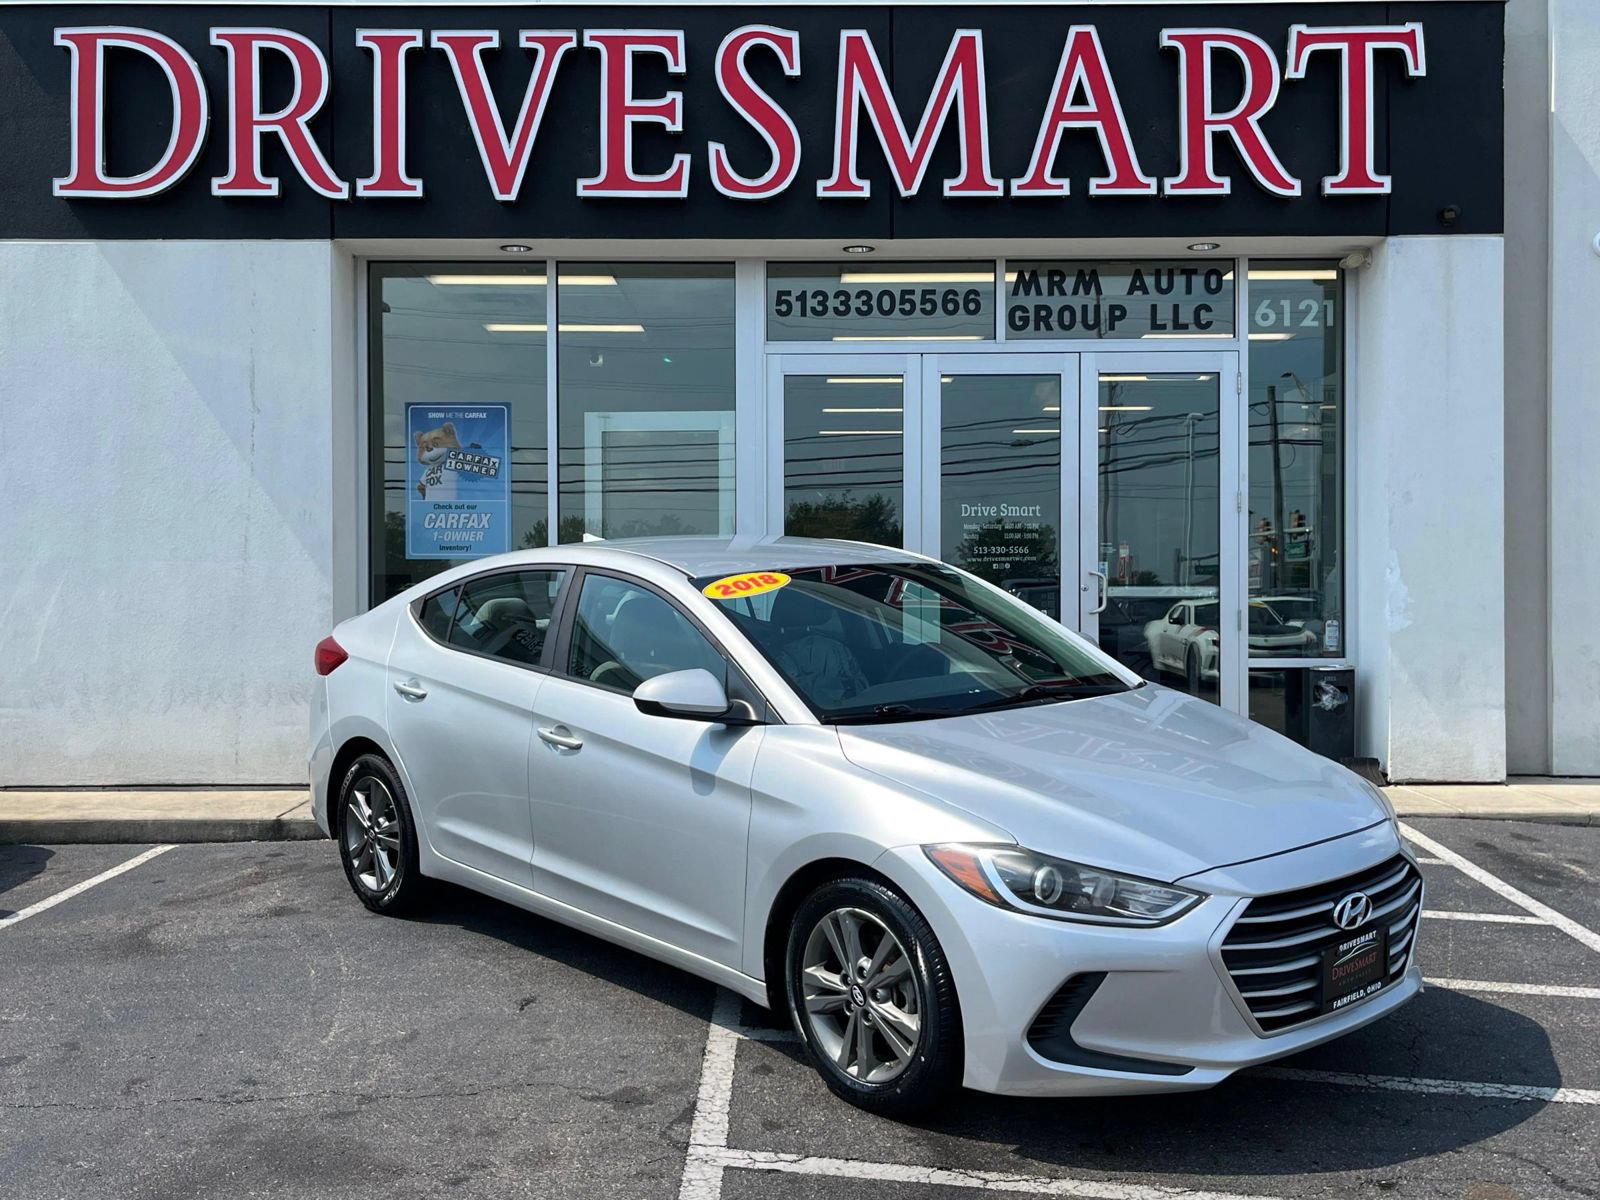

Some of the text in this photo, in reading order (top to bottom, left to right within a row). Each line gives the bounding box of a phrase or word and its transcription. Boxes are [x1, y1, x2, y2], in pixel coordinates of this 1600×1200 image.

[53, 23, 1427, 201] DRIVESMART
[1012, 268, 1223, 297] MRM AUTO
[775, 289, 982, 318] 5133305566
[1254, 299, 1335, 328] 6121
[1008, 303, 1214, 332] GROUP LLC
[449, 451, 499, 467] CARFAX
[426, 475, 443, 487] FOX
[433, 503, 453, 511] Check
[961, 503, 1041, 517] Drive Smart
[424, 513, 491, 529] CARFAX
[432, 531, 484, 542] 1-OWNER
[973, 546, 1029, 554] 513-330-5566
[716, 575, 779, 596] 2018
[1339, 930, 1377, 951] DRIVESMART
[1333, 981, 1382, 1009] FAIRFIELD, OHIO
